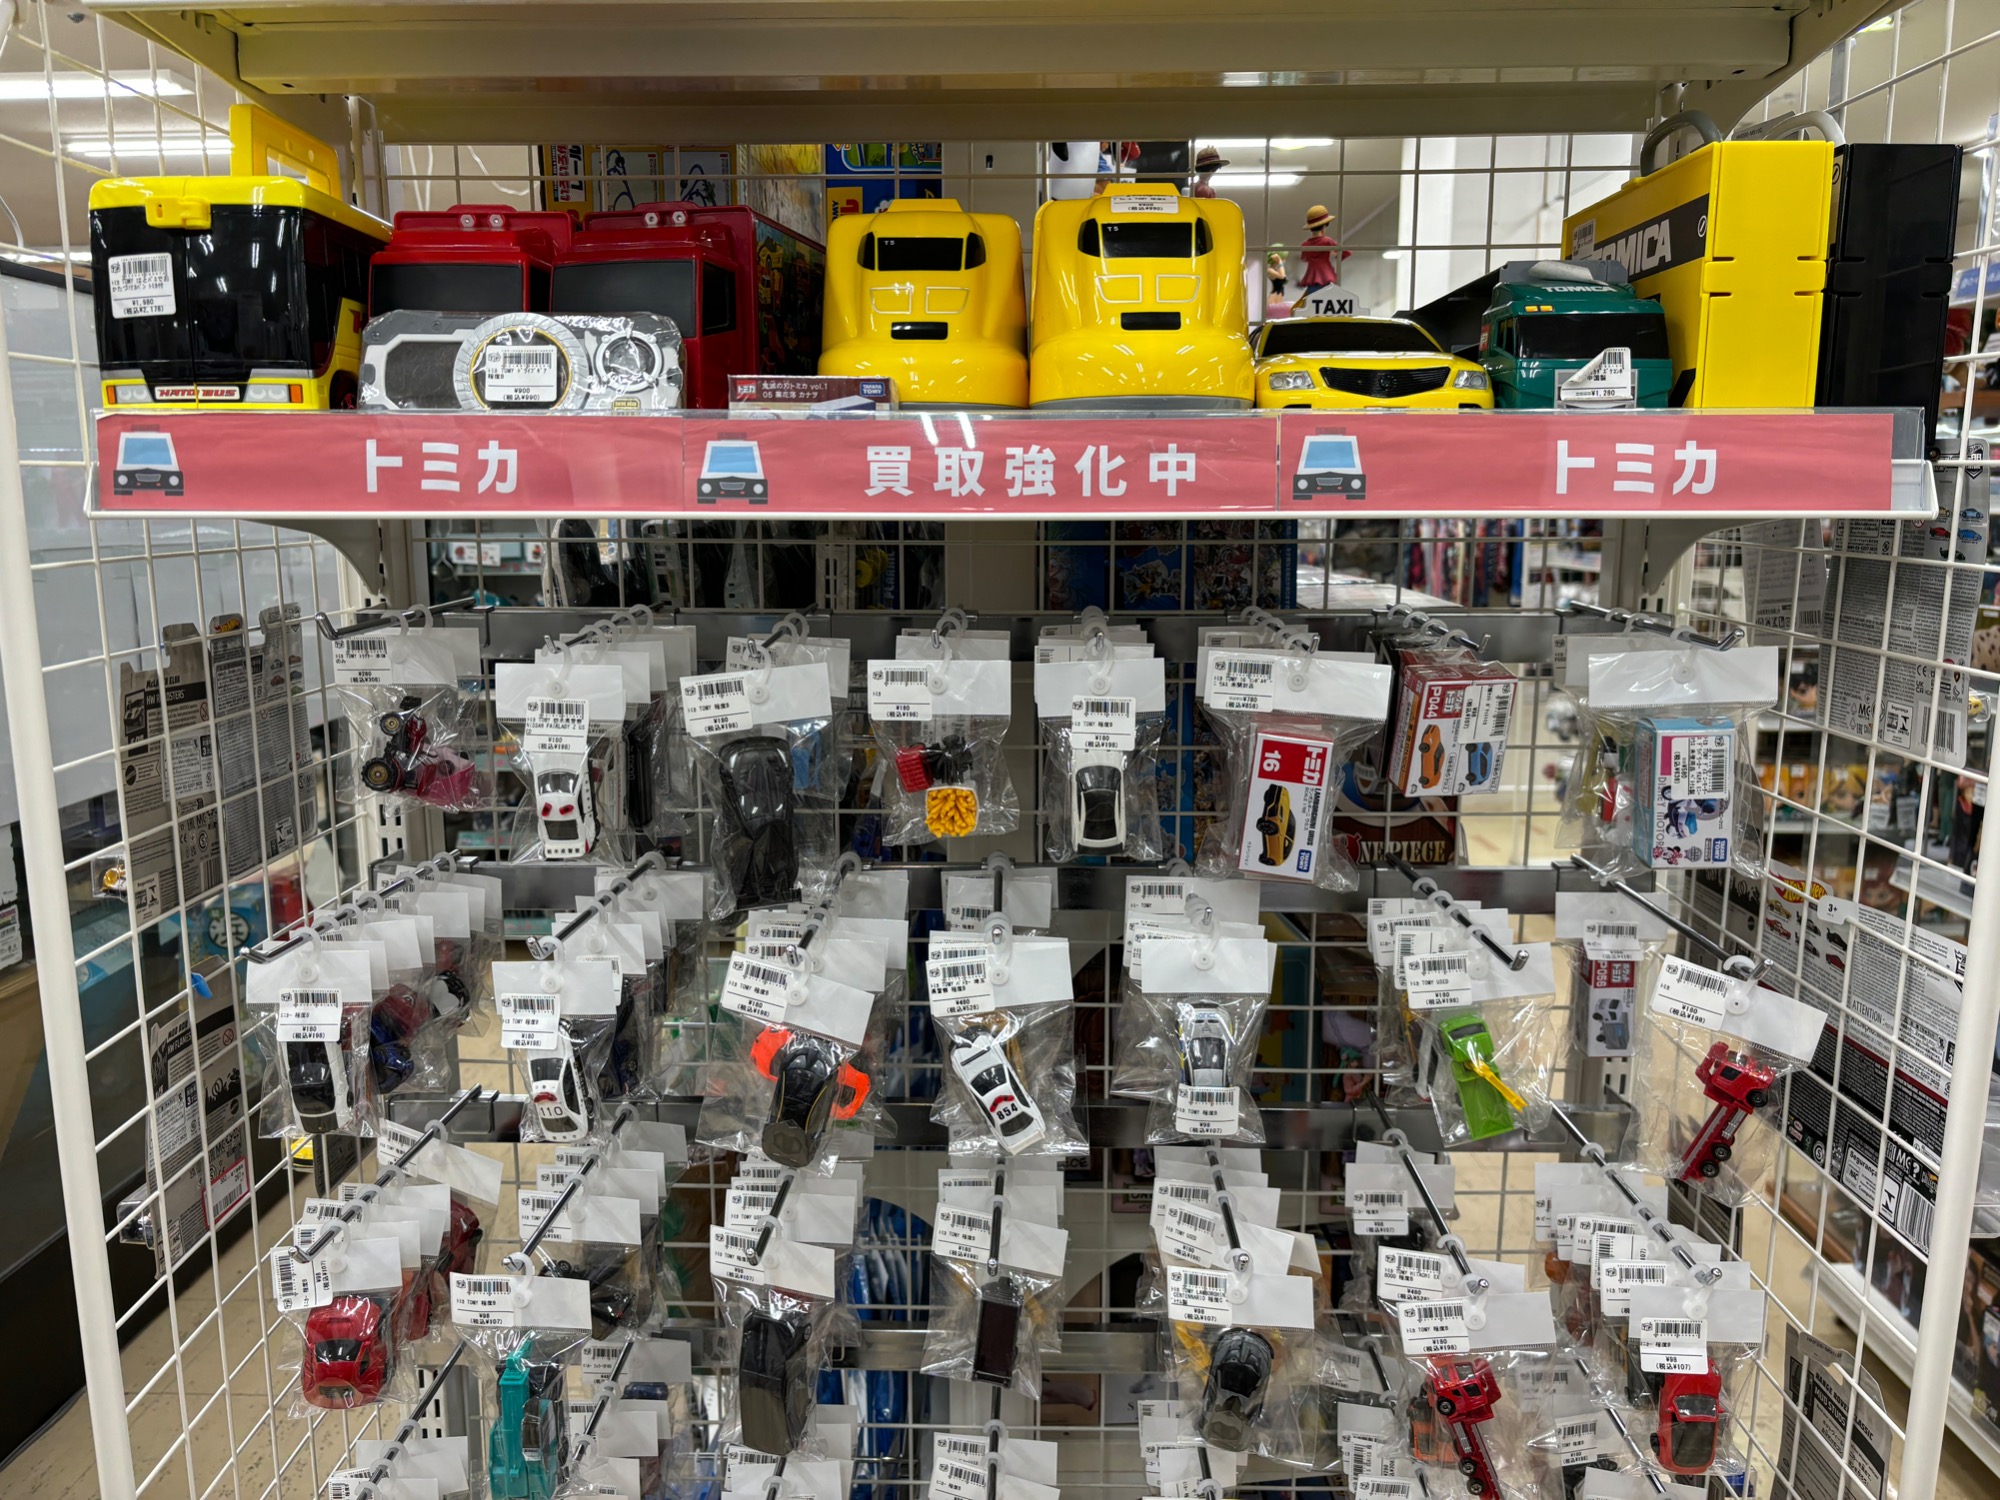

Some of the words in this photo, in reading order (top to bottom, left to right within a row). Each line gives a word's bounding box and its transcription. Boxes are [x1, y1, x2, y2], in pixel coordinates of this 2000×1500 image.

[124, 306, 164, 315] (税込¥2,178)
[1312, 299, 1354, 314] TAXI
[158, 389, 197, 397] HATO
[202, 388, 236, 397] BUS
[738, 384, 755, 394] トミカ
[366, 439, 518, 494] トミカ
[864, 444, 1196, 497] 買取強化中
[1556, 440, 1717, 496] トミカ
[1426, 686, 1442, 718] P044
[1443, 690, 1454, 714] トミカ
[704, 722, 738, 732] (税込¥198)
[1262, 750, 1281, 772] 16
[1302, 746, 1323, 785] トミカ
[1311, 788, 1322, 829] LAMBORGHINI
[1306, 830, 1316, 846] URUS
[1388, 841, 1445, 862] PIECE
[1828, 904, 1838, 912] 3+
[1596, 961, 1607, 987] P056
[1612, 963, 1620, 983] トミカ
[737, 1004, 770, 1018] (税込¥198)
[748, 1000, 763, 1008] ¥180
[1681, 1004, 1698, 1014] ¥180
[1669, 1007, 1706, 1024] (税込¥198)
[540, 1106, 563, 1117] 110
[996, 1103, 1018, 1120] 854
[726, 1271, 754, 1281] (税込¥107)
[1184, 1313, 1217, 1322] (税込¥107)
[1423, 1344, 1457, 1352] (税込¥198)
[1815, 1372, 1834, 1394] RANGE
[1815, 1386, 1828, 1406] MUD
[1827, 1397, 1847, 1427] STUDS
